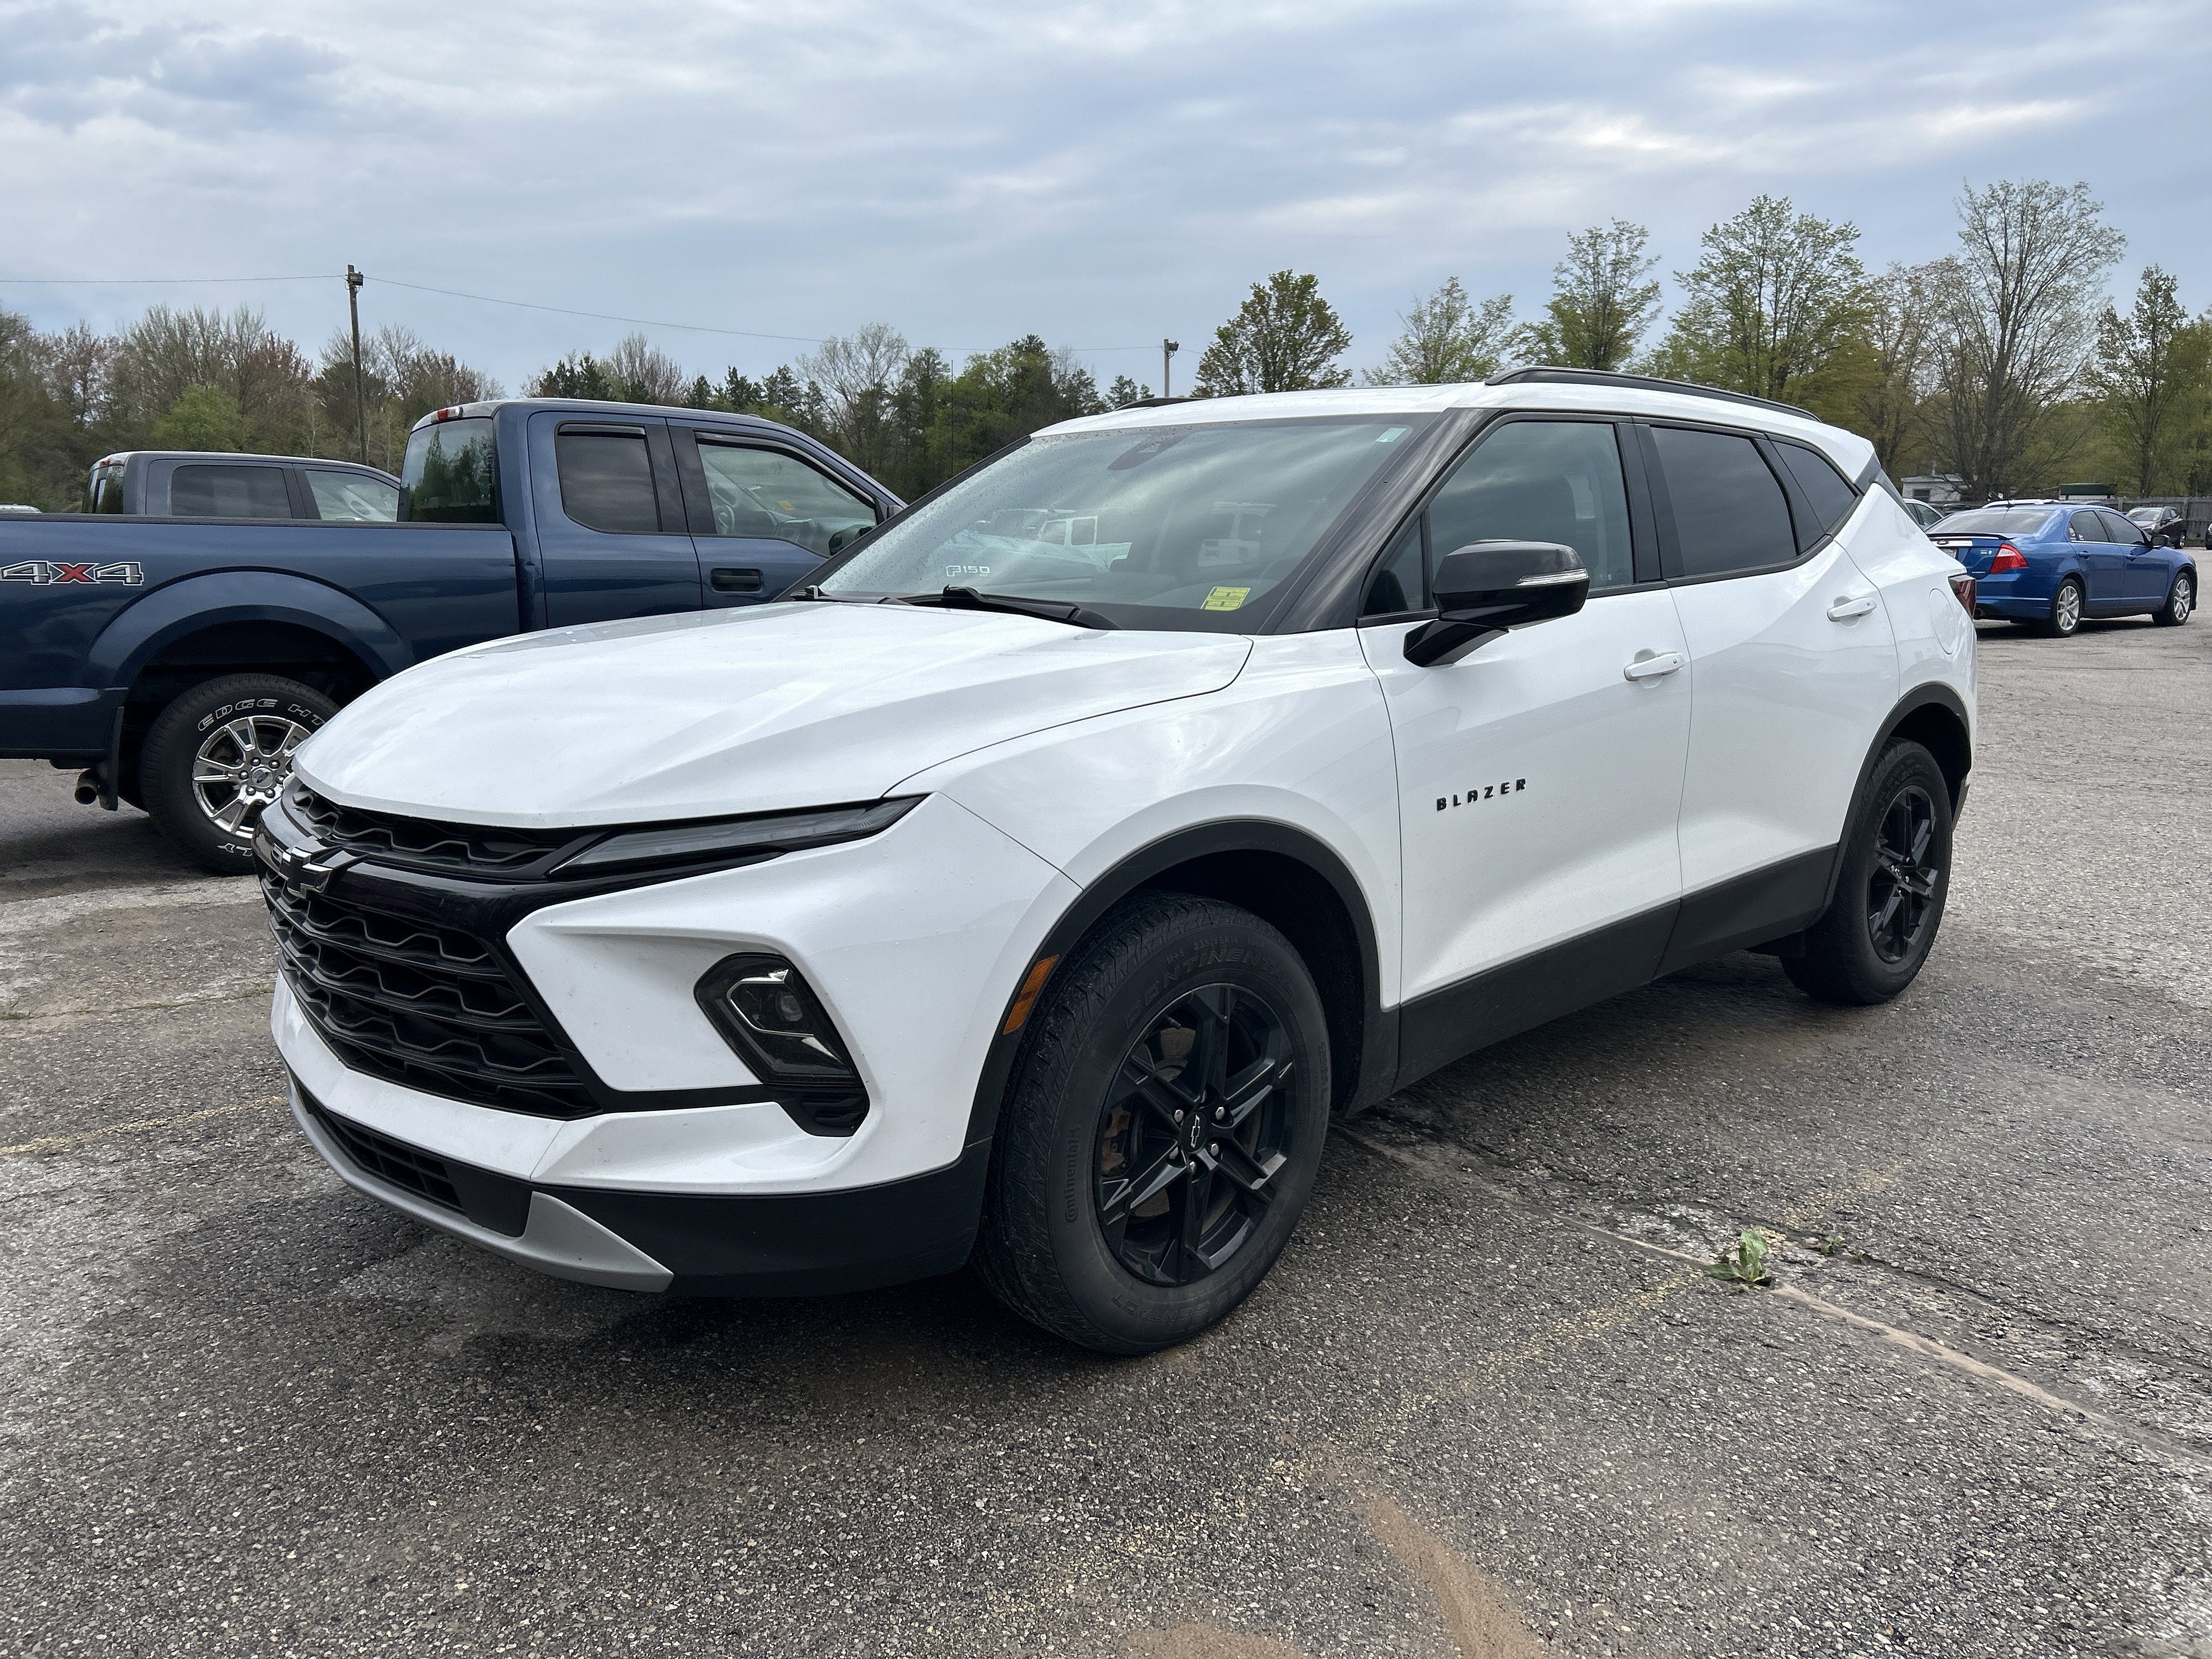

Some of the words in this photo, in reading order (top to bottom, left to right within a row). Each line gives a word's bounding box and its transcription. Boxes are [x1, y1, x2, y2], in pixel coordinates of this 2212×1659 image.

[198, 698, 278, 731] EDGE
[287, 703, 326, 726] HT
[1436, 778, 1526, 811] BLAZER
[1193, 935, 1239, 951] 235/65R18
[1124, 949, 1295, 1030] CONTINENTAL
[1063, 1138, 1079, 1223] Continental
[1111, 1294, 1211, 1323] CONTACT
